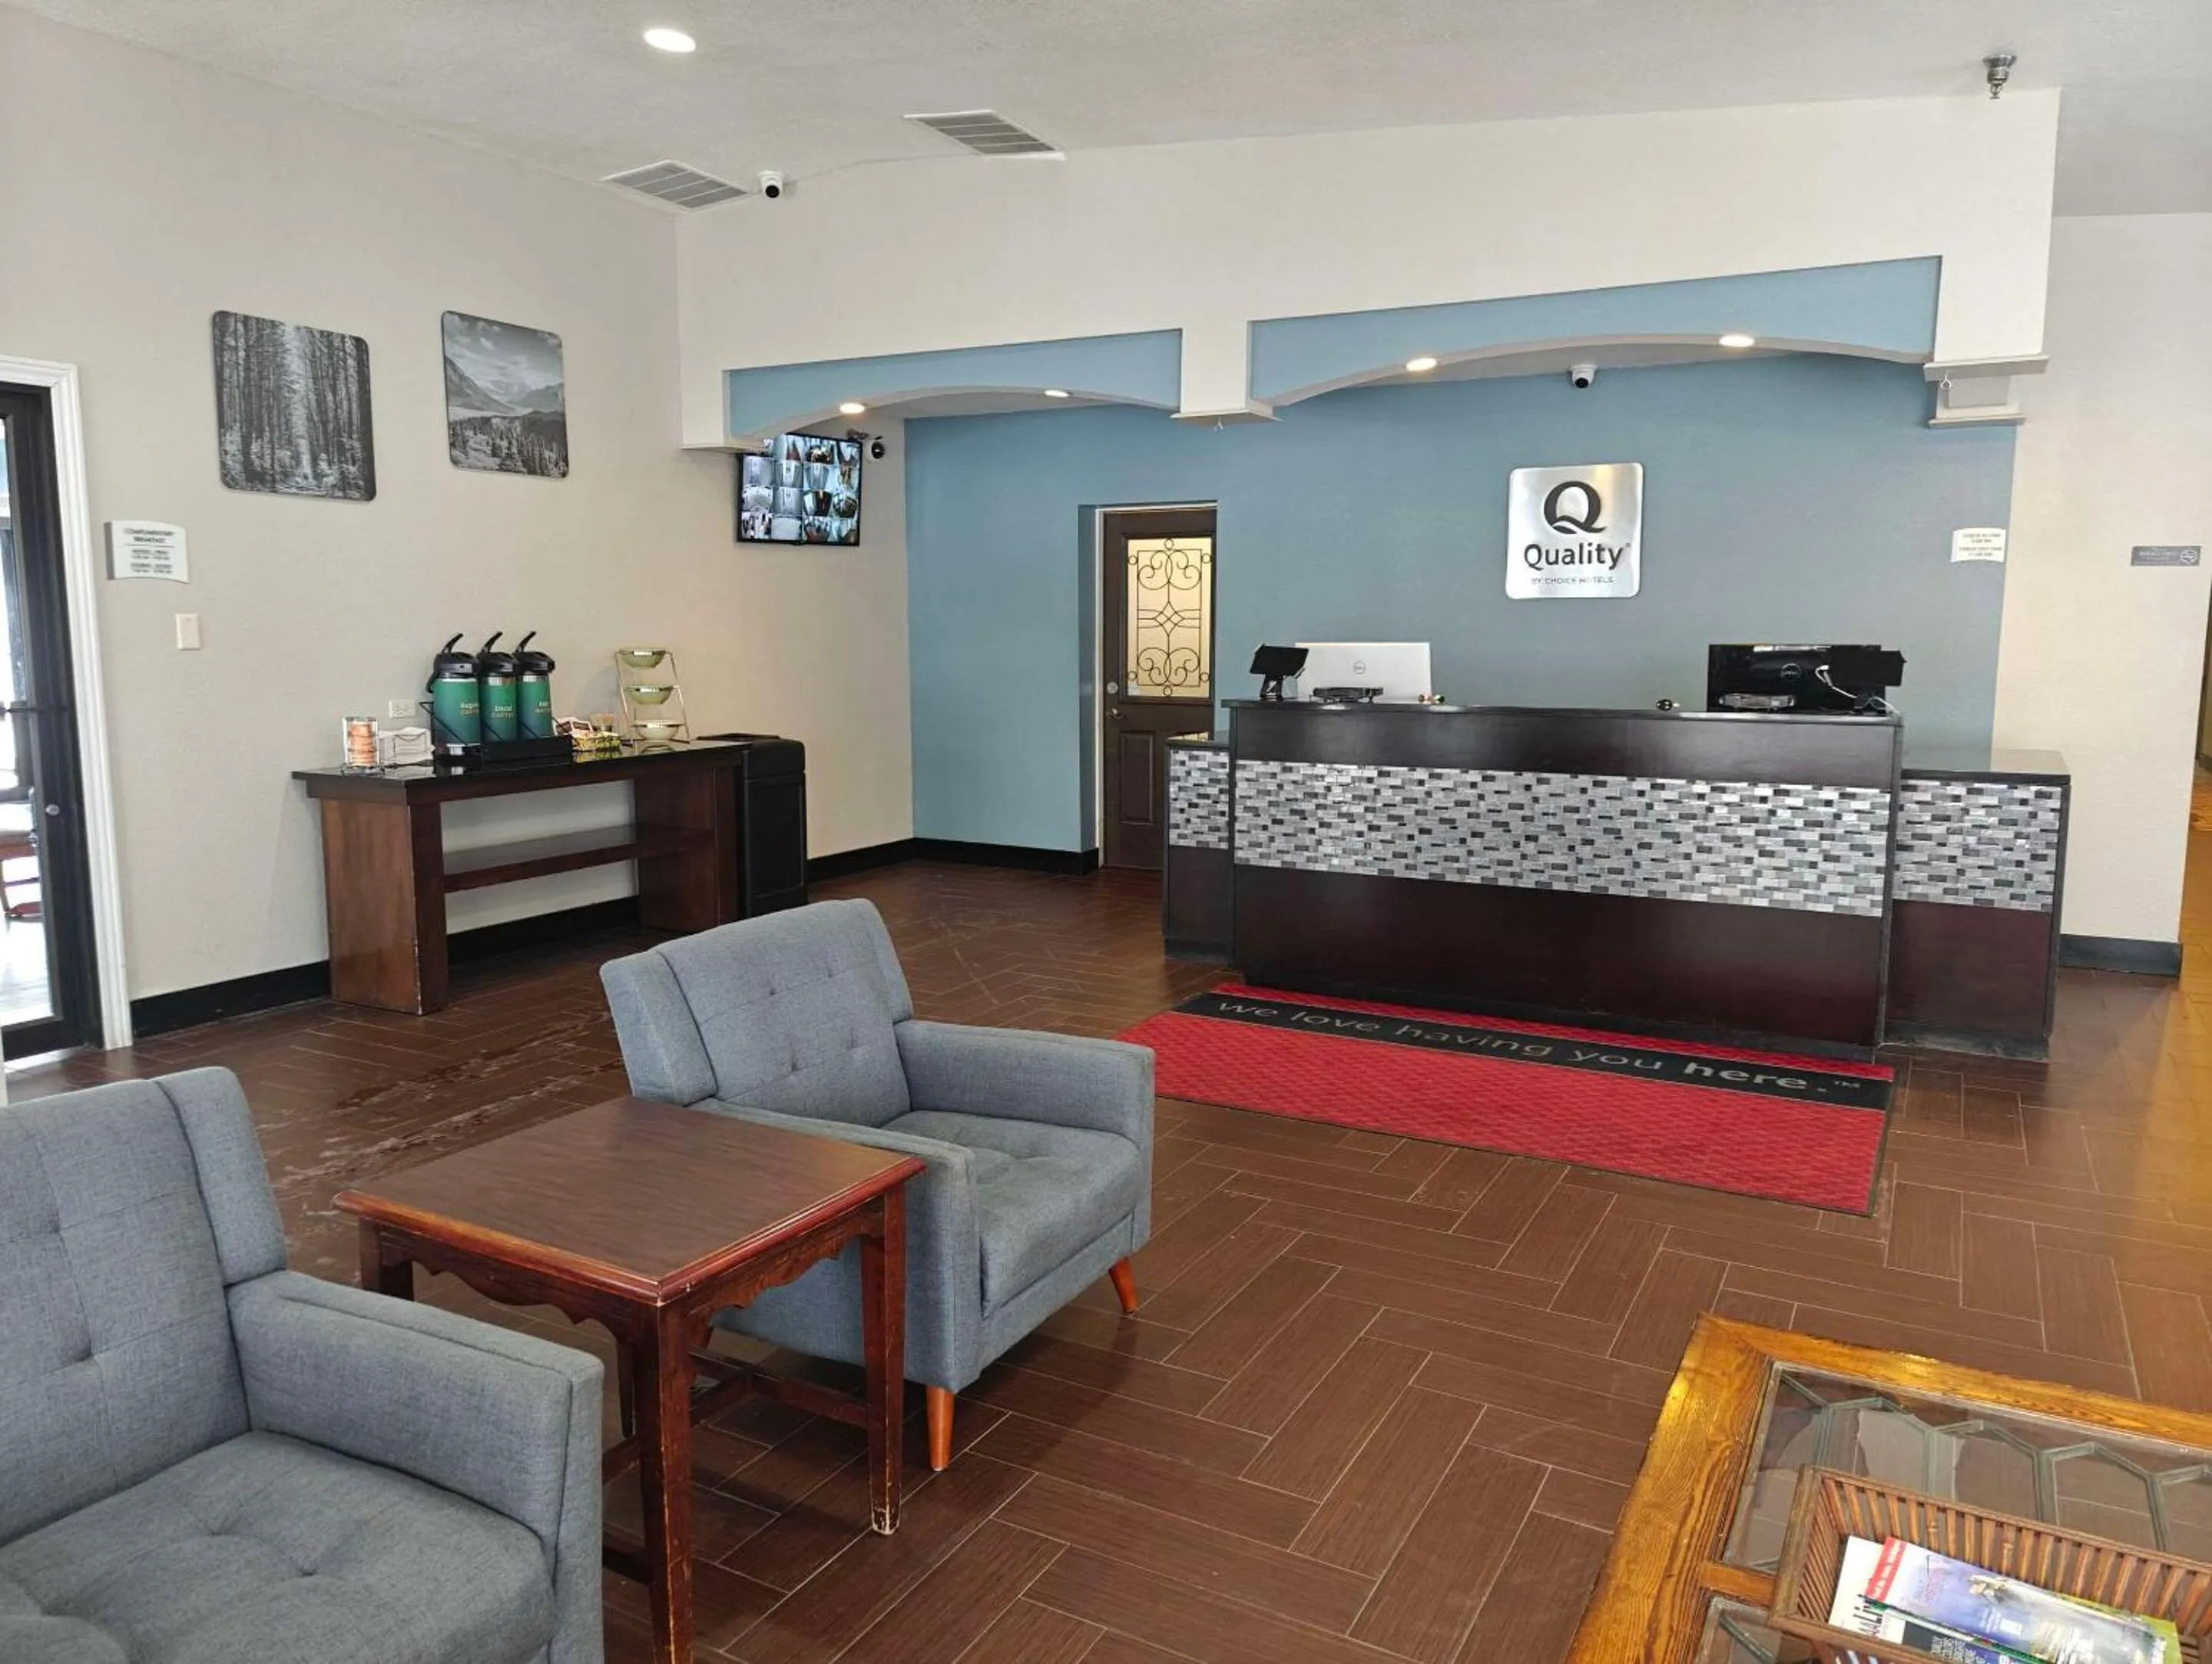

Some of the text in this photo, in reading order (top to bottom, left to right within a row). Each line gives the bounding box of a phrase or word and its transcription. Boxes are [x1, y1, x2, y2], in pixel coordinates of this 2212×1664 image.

[1544, 481, 1607, 534] Q
[1524, 542, 1624, 571] Quality
[1219, 1002, 1279, 1017] we
[1290, 1011, 1381, 1032] love
[1394, 1024, 1554, 1057] having
[1568, 1049, 1664, 1070] you
